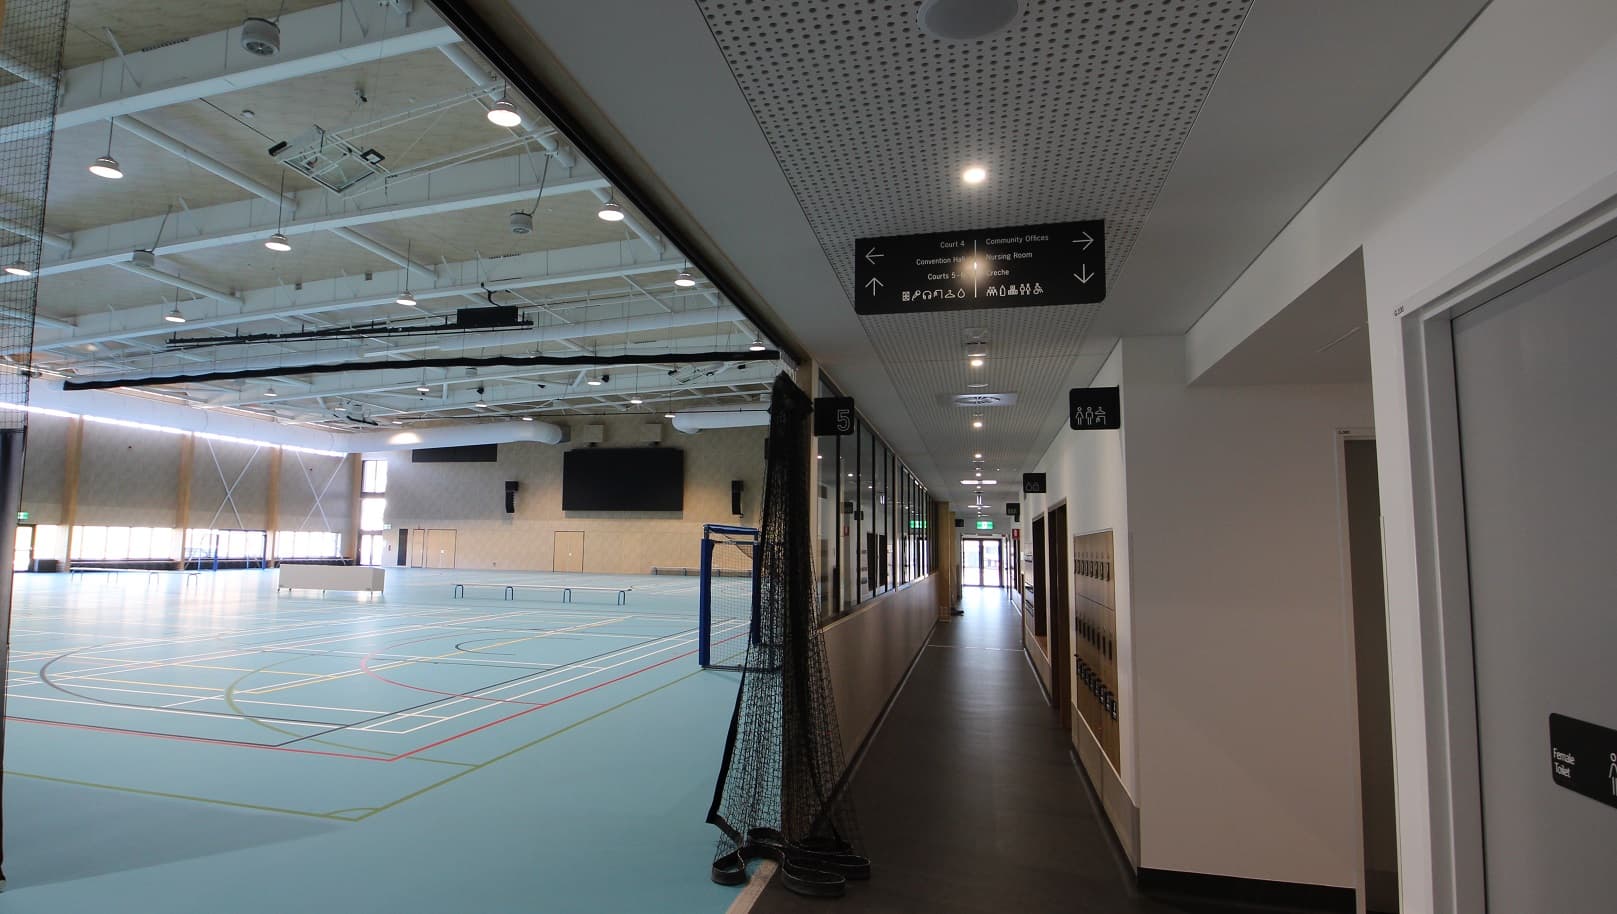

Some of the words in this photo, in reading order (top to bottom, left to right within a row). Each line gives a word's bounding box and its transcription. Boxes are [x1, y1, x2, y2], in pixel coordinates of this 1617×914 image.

[985, 236, 1023, 245] Community
[1025, 234, 1049, 242] Offices
[916, 257, 952, 266] Convention
[952, 255, 967, 264] Hall
[985, 253, 1012, 261] Nursing
[1013, 251, 1033, 259] Room
[927, 272, 949, 281] Courts
[836, 408, 850, 432] 5
[1552, 747, 1576, 766] Female
[1554, 761, 1572, 778] Toilet
